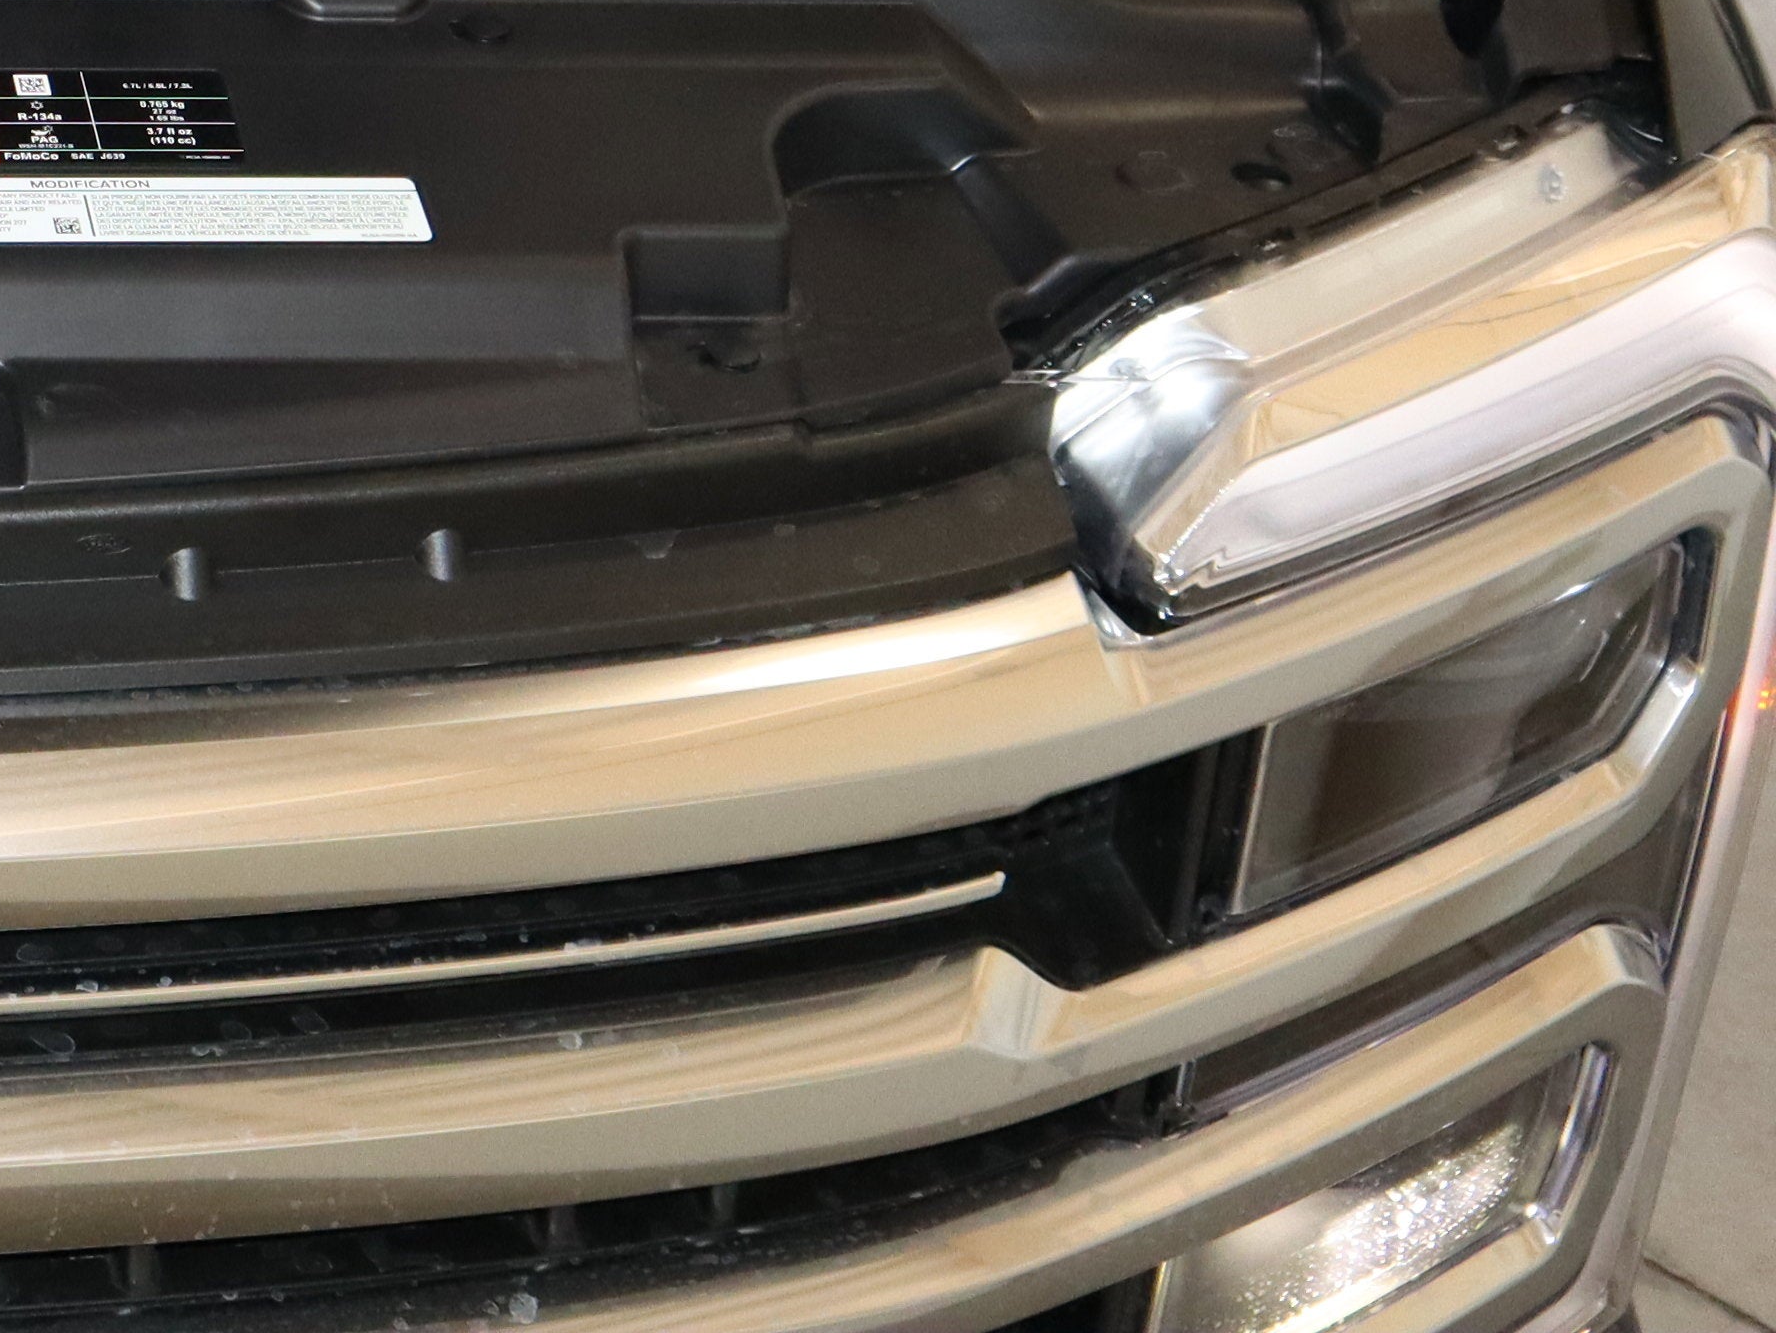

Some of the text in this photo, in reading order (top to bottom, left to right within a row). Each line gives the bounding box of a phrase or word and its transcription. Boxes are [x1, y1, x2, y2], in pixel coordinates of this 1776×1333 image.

[139, 100, 185, 109] 0.765 kg
[17, 112, 62, 121] R-134a
[146, 127, 163, 135] 3.7
[30, 135, 59, 143] PAG
[150, 136, 196, 145] (110 cc)
[4, 152, 126, 160] FoMoCo SAE J639
[30, 180, 151, 189] MODIFICATION
